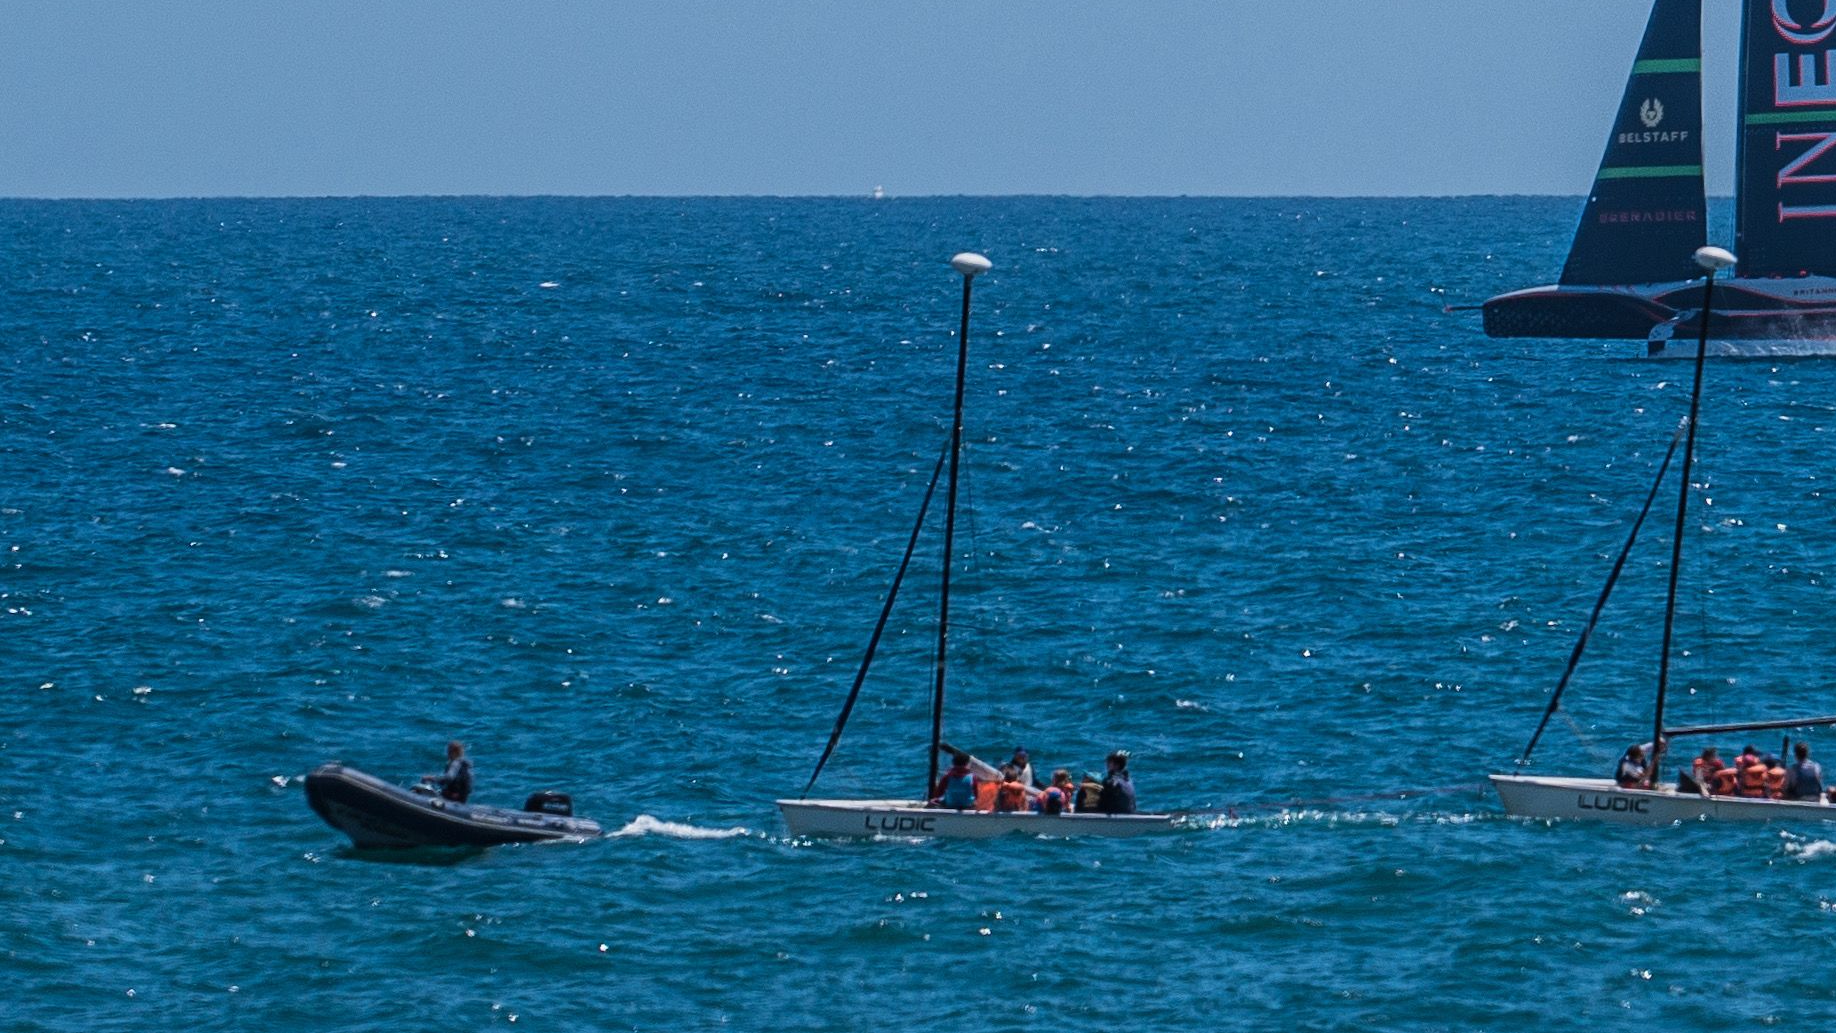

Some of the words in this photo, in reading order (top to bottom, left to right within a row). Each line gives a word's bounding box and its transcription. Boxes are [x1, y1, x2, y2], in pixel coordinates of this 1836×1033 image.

[1618, 131, 1688, 143] BELSTAFF
[1578, 793, 1649, 814] LUDIC
[865, 814, 936, 832] LUDIC
